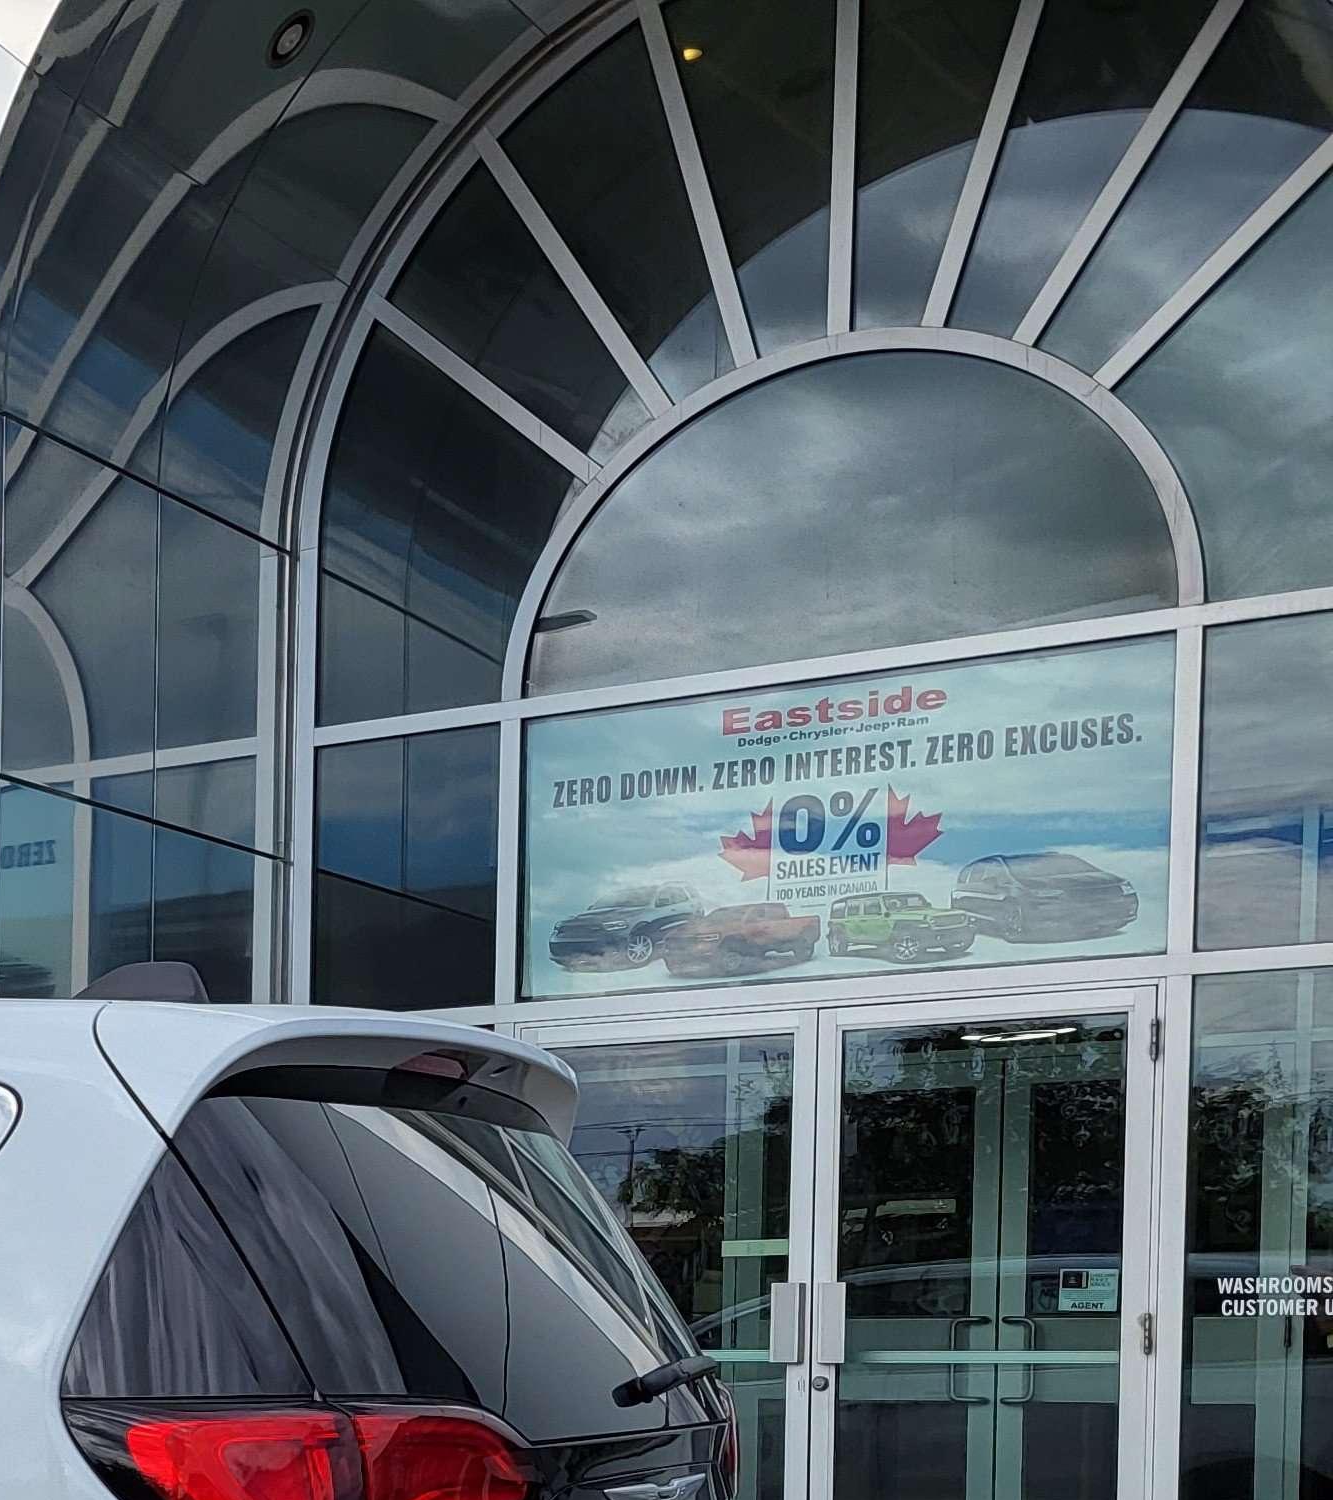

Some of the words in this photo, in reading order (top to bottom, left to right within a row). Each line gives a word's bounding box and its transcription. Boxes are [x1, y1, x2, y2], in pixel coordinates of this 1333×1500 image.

[722, 686, 947, 736] Eastside
[553, 775, 612, 808] ZERO
[620, 765, 704, 800] DOWN.
[712, 756, 775, 790] ZERO
[784, 739, 916, 782] INTEREST.
[925, 729, 994, 766] ZERO
[1004, 712, 1142, 757] EXCUSES.
[779, 787, 881, 856] 0%
[776, 858, 825, 880] SALES
[829, 852, 881, 875] EVENT
[776, 888, 793, 901] 100
[795, 885, 826, 900] YEARS
[827, 885, 837, 897] IN
[839, 881, 878, 895] CANADA
[1217, 1276, 1333, 1294] WASHROOMS
[1221, 1299, 1318, 1316] CUSTOMER
